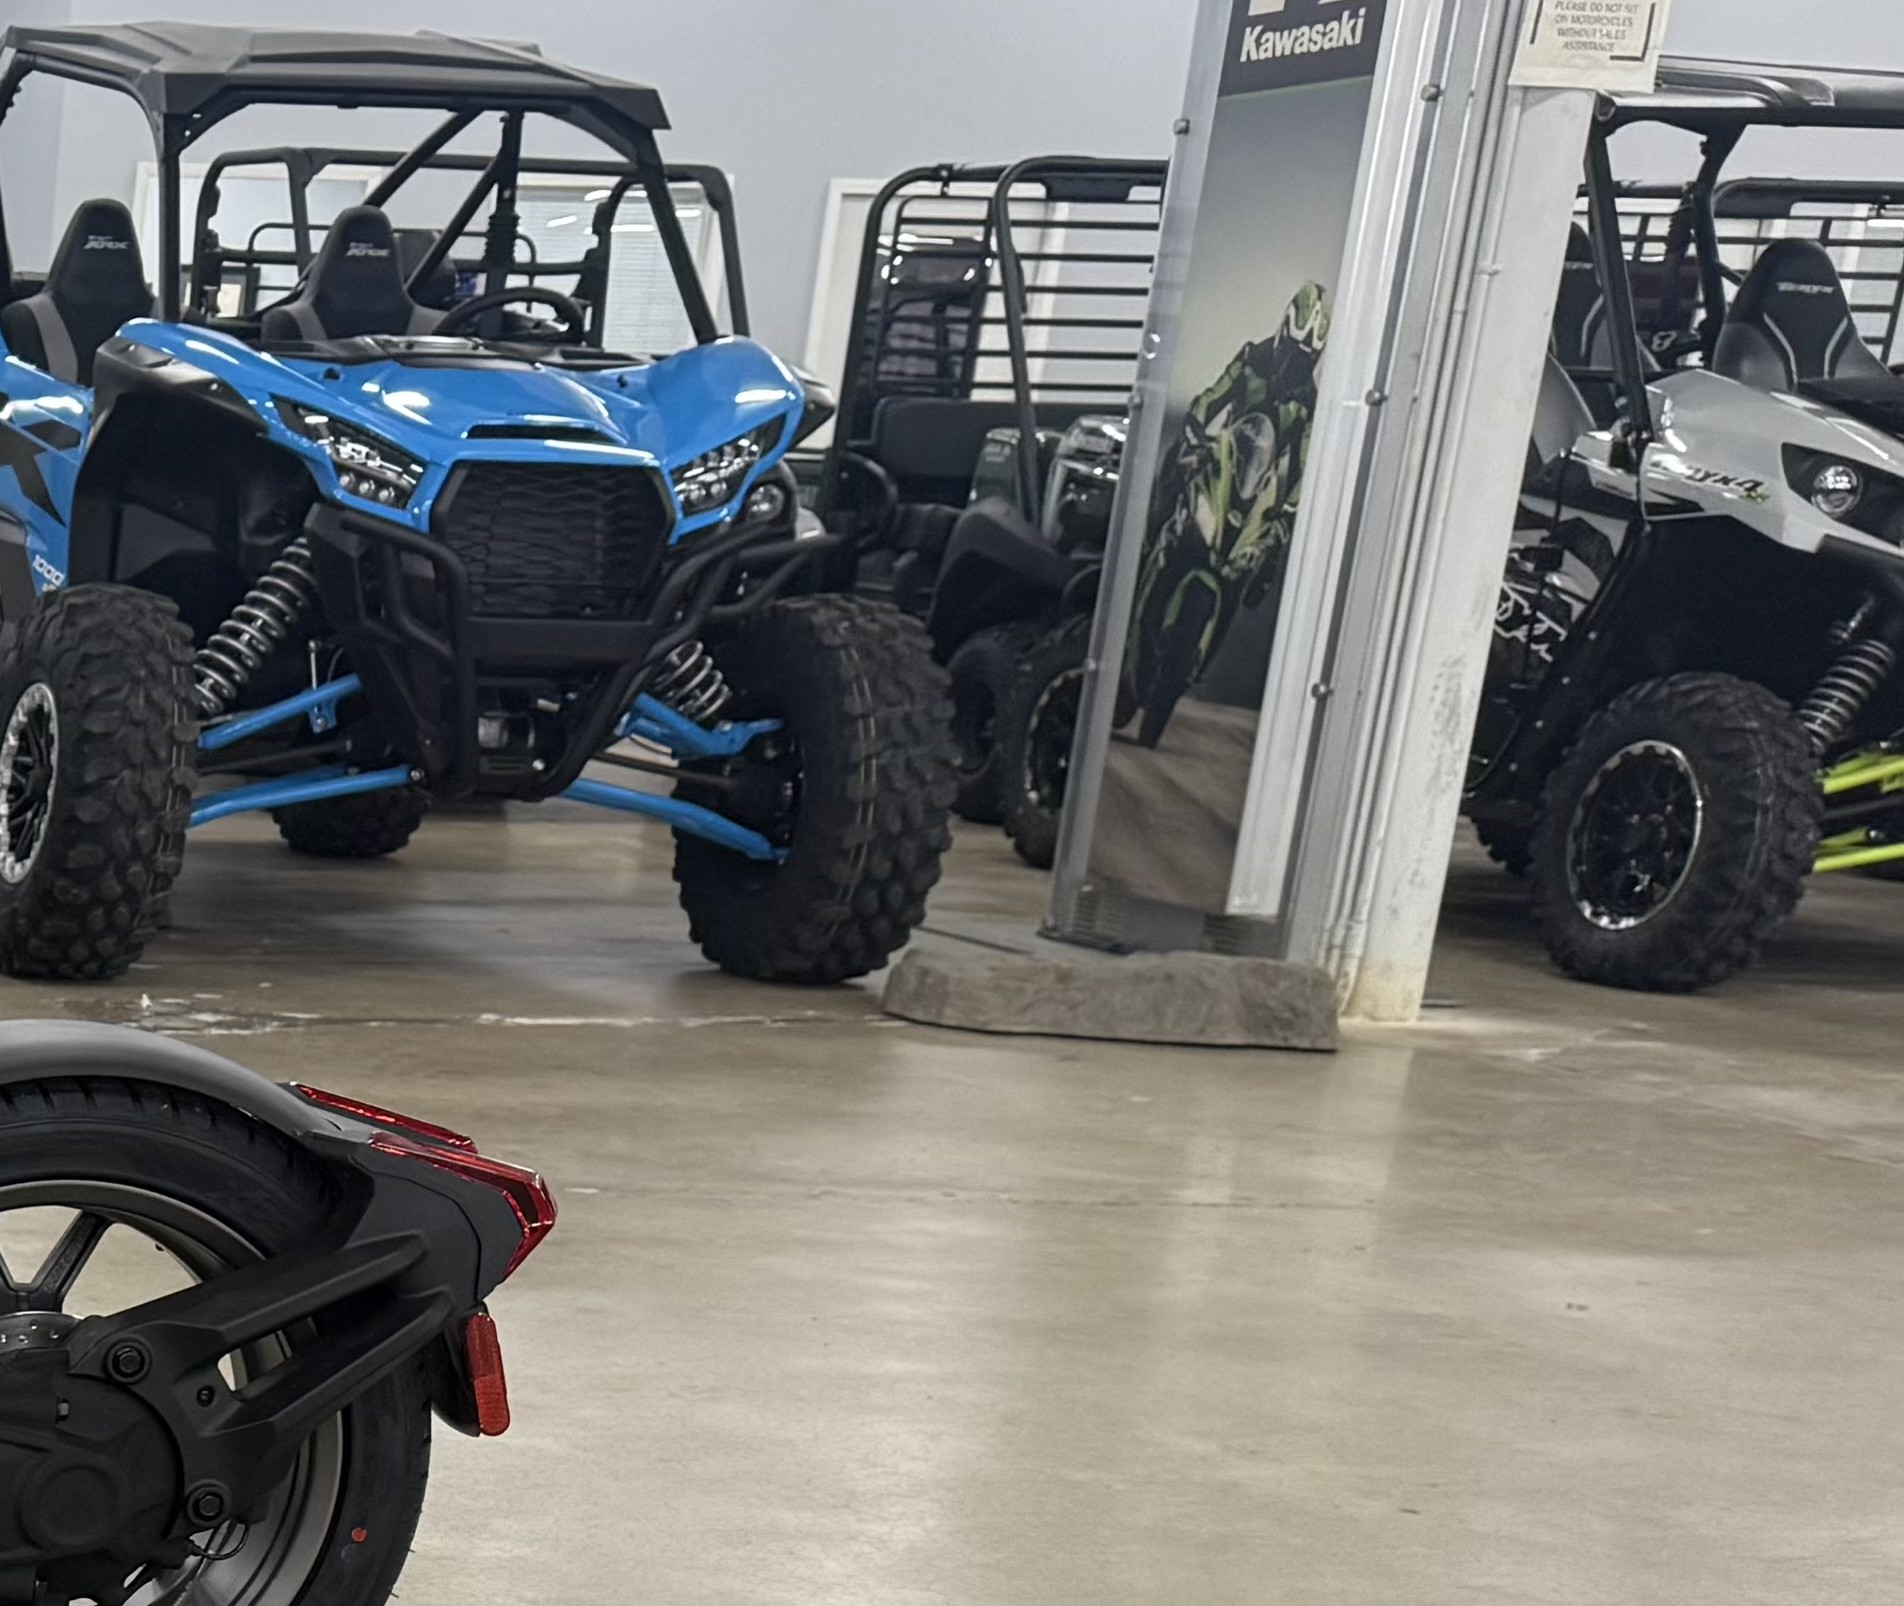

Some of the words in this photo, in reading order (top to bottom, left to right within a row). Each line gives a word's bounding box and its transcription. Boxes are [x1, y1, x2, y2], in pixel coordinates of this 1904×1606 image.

[1555, 1, 1587, 12] PLEASE
[1590, 2, 1603, 12] DO
[1605, 3, 1622, 13] NOT
[1625, 3, 1639, 14] SIT
[1554, 14, 1567, 24] ON
[1570, 14, 1633, 27] MOTORCYCLES
[1240, 7, 1366, 62] Kawasaki
